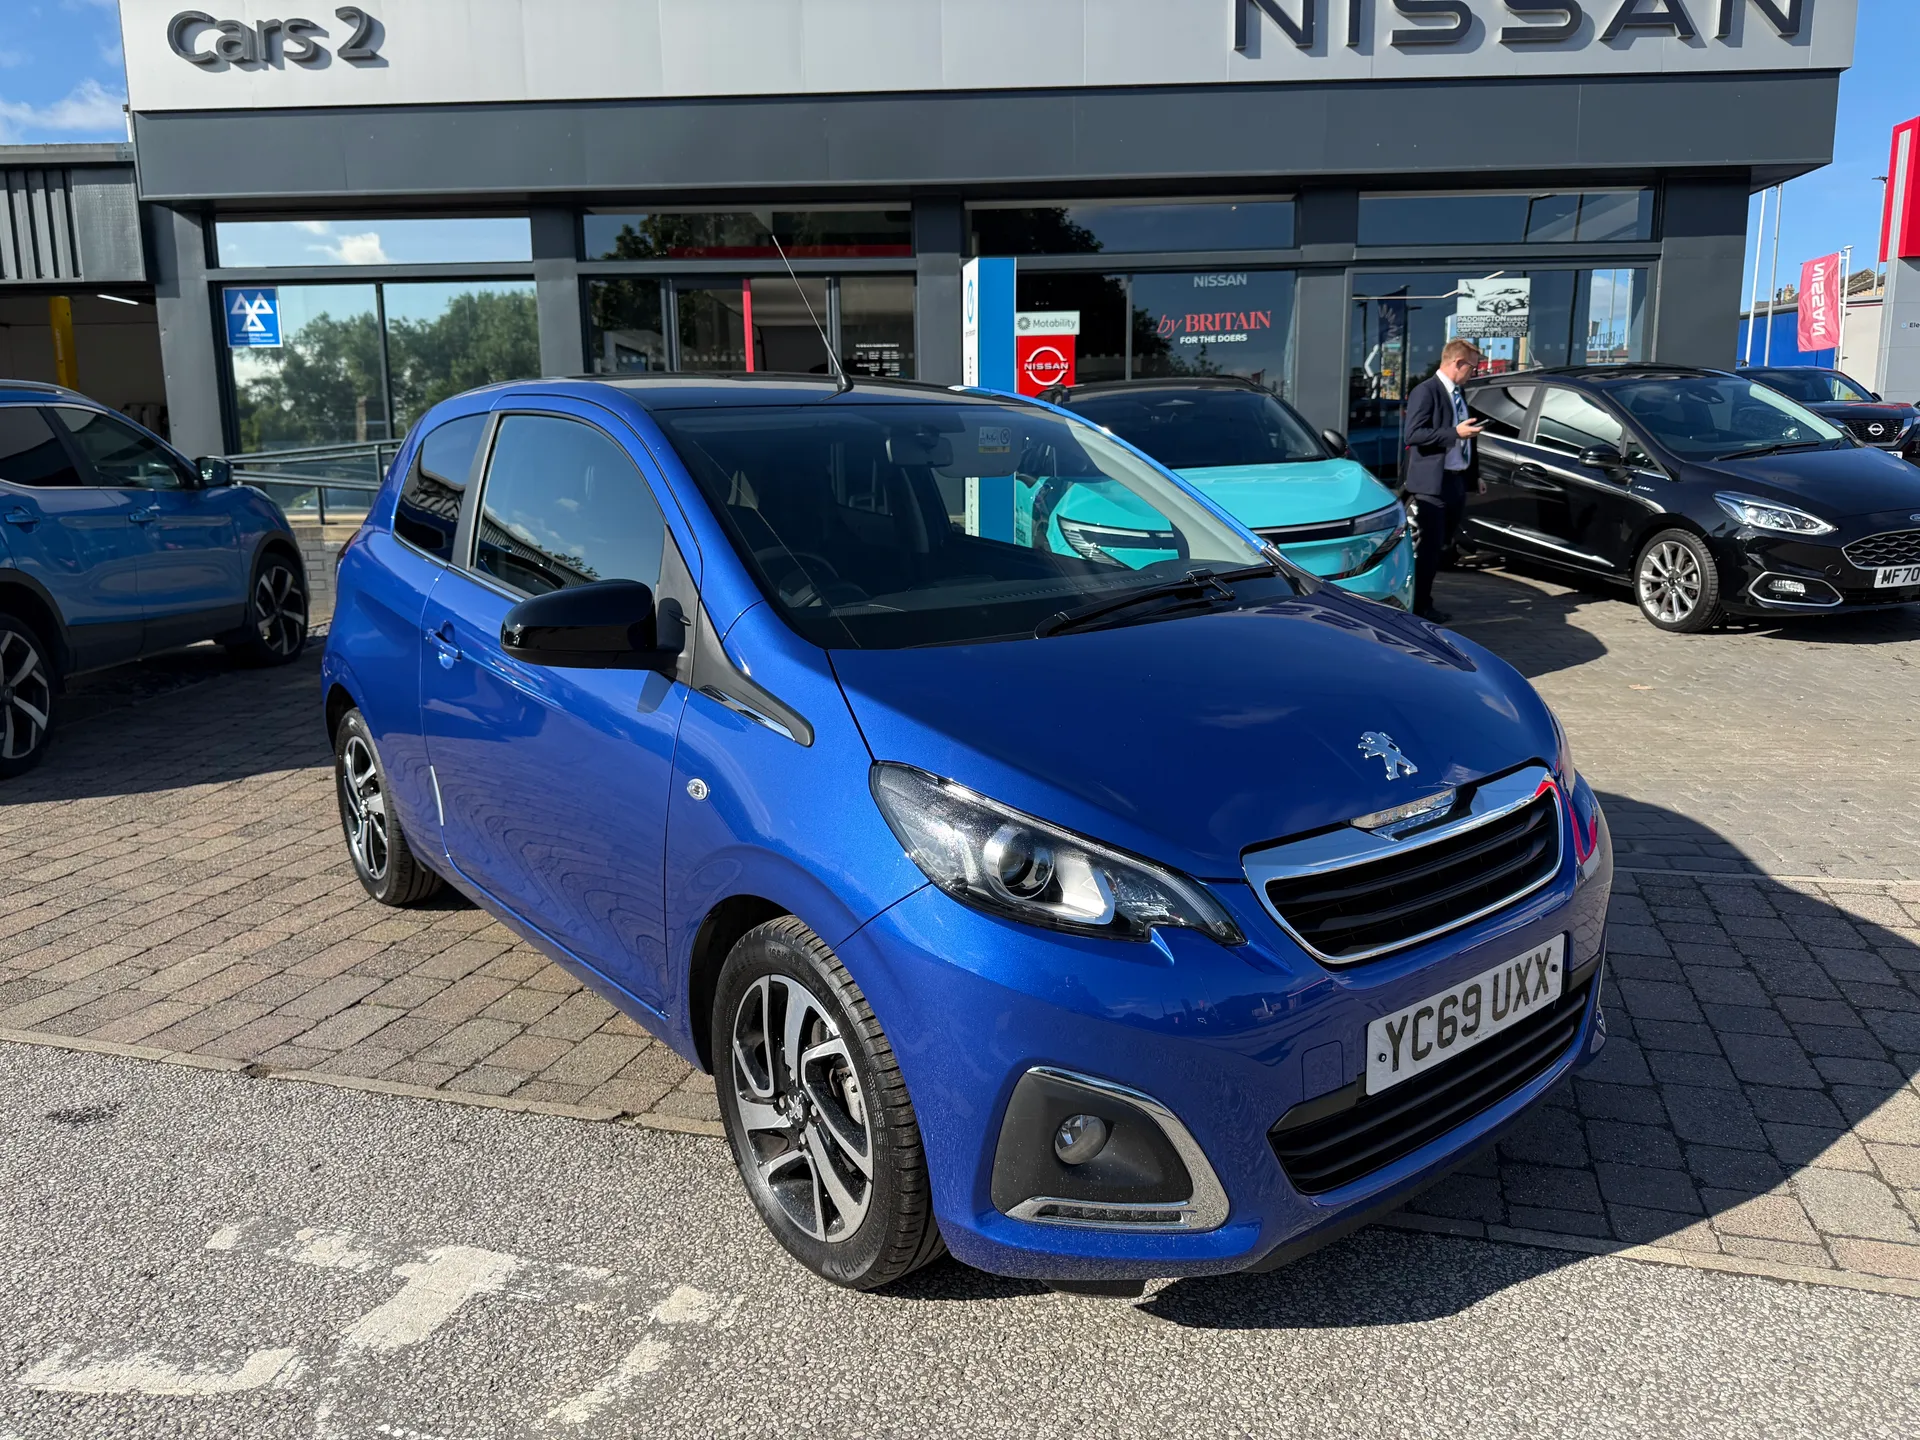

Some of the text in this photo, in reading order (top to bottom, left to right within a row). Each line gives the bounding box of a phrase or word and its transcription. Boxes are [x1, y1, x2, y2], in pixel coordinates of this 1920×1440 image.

[167, 6, 377, 64] Cars 2
[1193, 273, 1247, 288] NISSAN
[1033, 319, 1076, 329] Motability
[1156, 310, 1272, 339] by BRITAIN
[1179, 333, 1248, 344] FOR THE DOERS
[1881, 567, 1920, 585] MF70
[1385, 947, 1552, 1073] YC69 UXX
